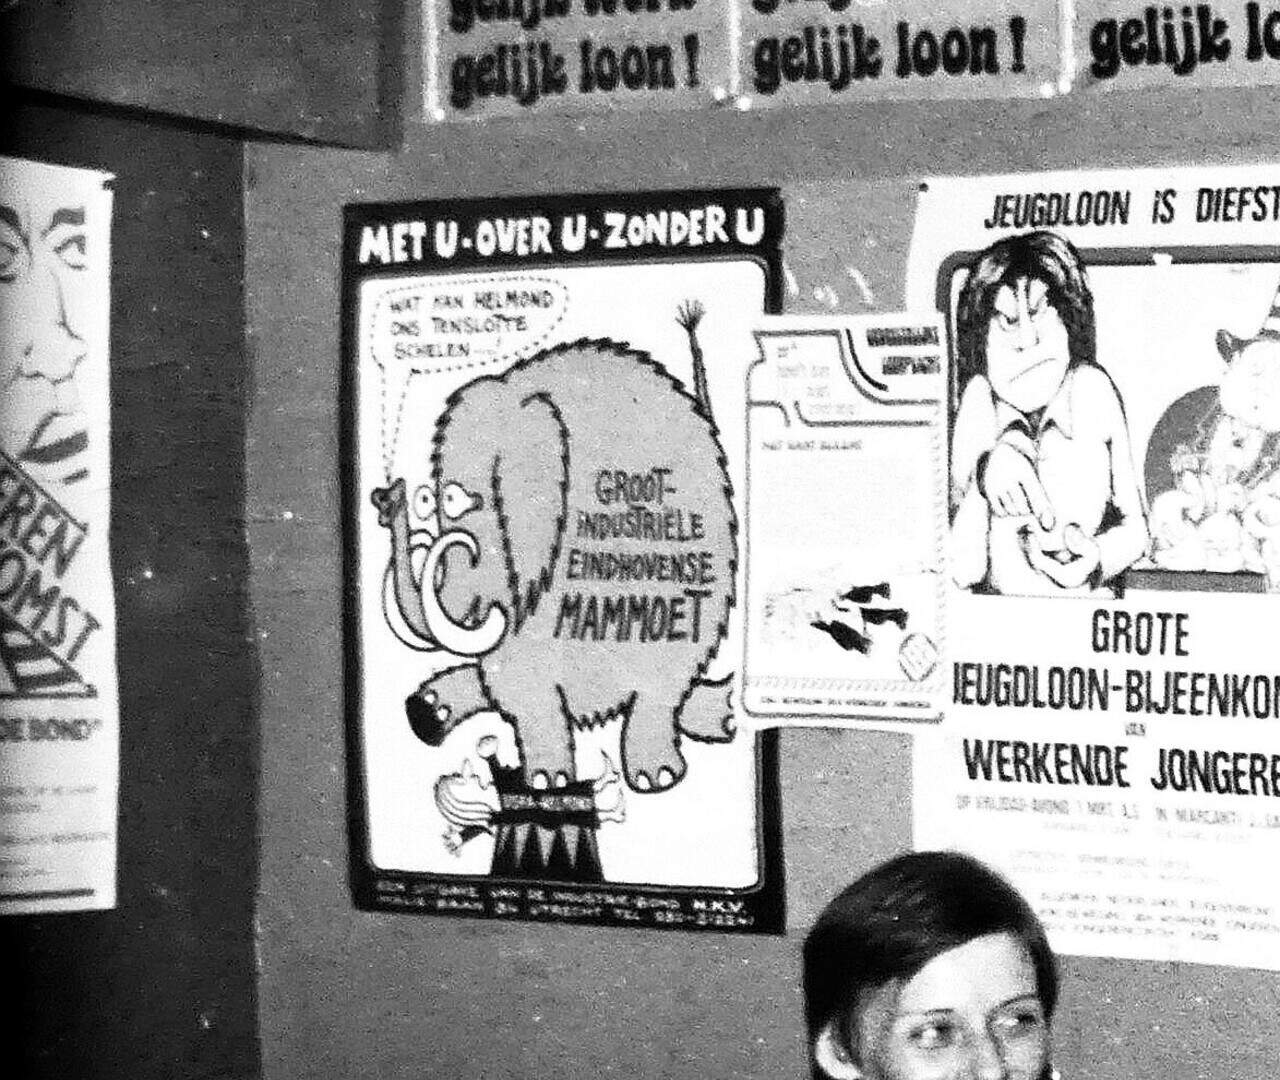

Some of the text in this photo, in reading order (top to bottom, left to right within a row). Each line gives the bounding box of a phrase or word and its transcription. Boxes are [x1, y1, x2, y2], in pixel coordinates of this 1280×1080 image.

[753, 24, 883, 94] gelijk
[1090, 3, 1231, 78] gelijk
[451, 42, 567, 109] gelijk
[984, 190, 1131, 230] JEUGDLOON
[1151, 188, 1177, 224] IS
[359, 220, 426, 264] MET
[735, 208, 765, 245] U
[431, 314, 528, 334] TENSLOTTE
[474, 290, 554, 310] HELMOND
[553, 588, 713, 643] MAMMOET
[1091, 609, 1190, 656] GROTE
[963, 739, 1131, 787] WERKENDE
